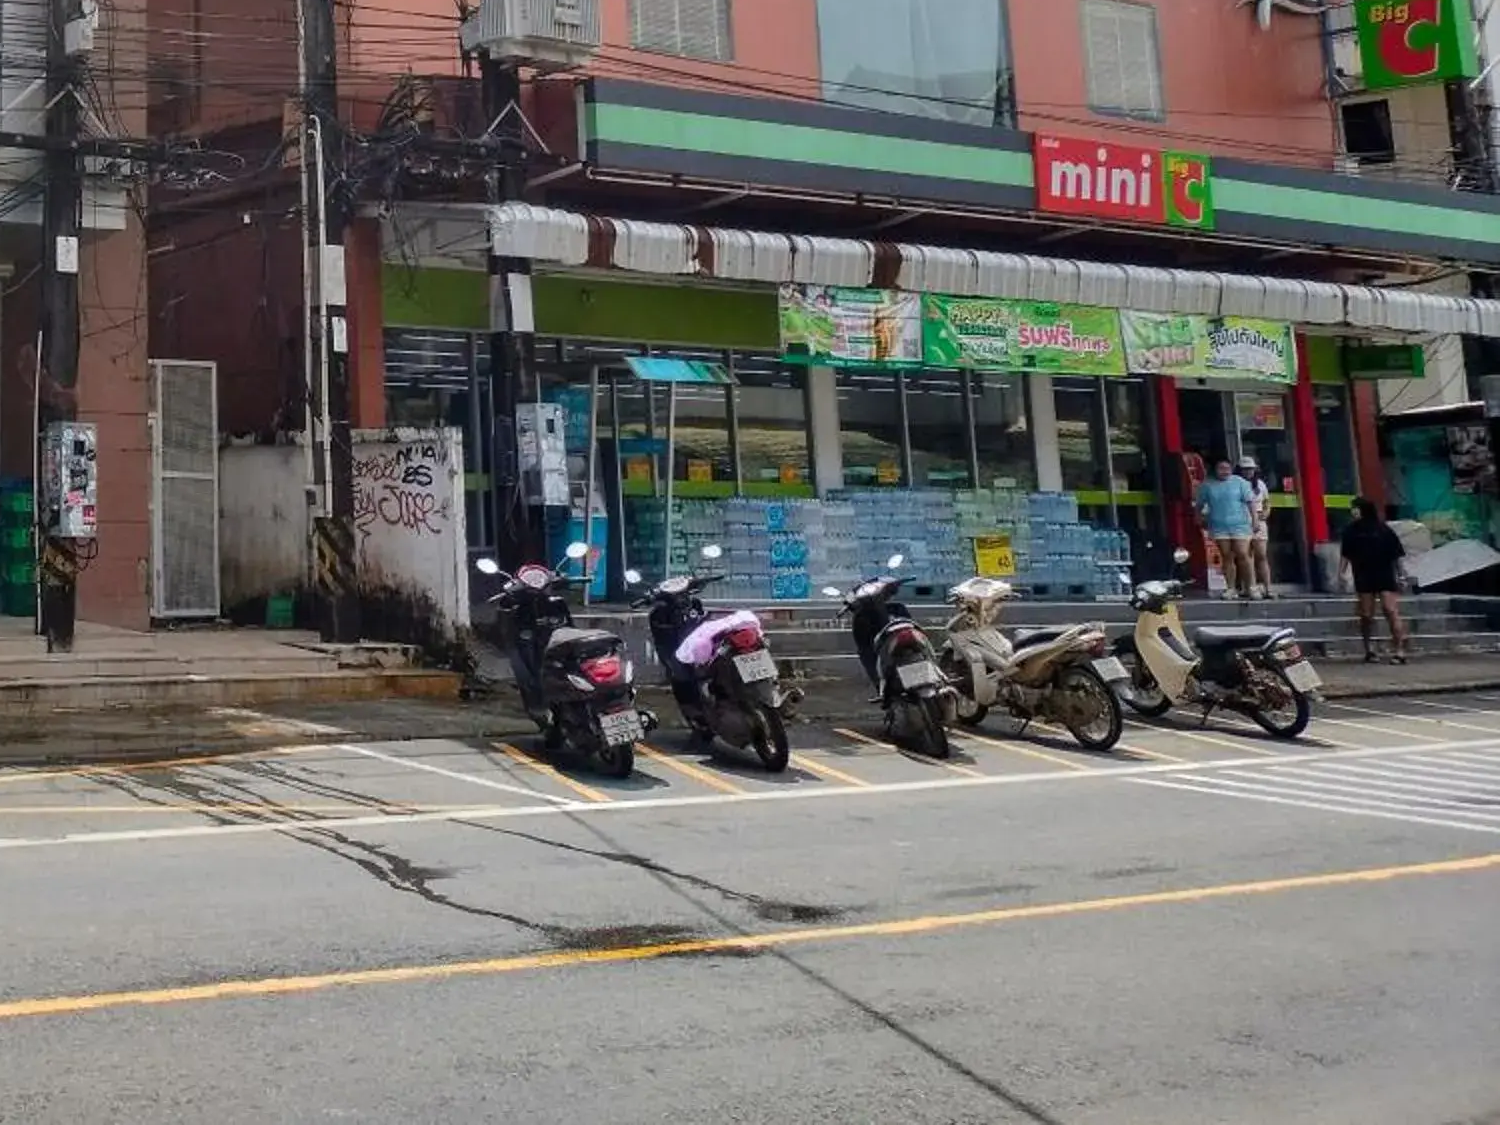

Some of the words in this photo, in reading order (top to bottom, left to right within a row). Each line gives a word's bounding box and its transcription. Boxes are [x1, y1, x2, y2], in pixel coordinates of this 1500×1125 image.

[1369, 0, 1410, 24] Big
[1050, 147, 1152, 206] mini
[1173, 161, 1206, 224] C
